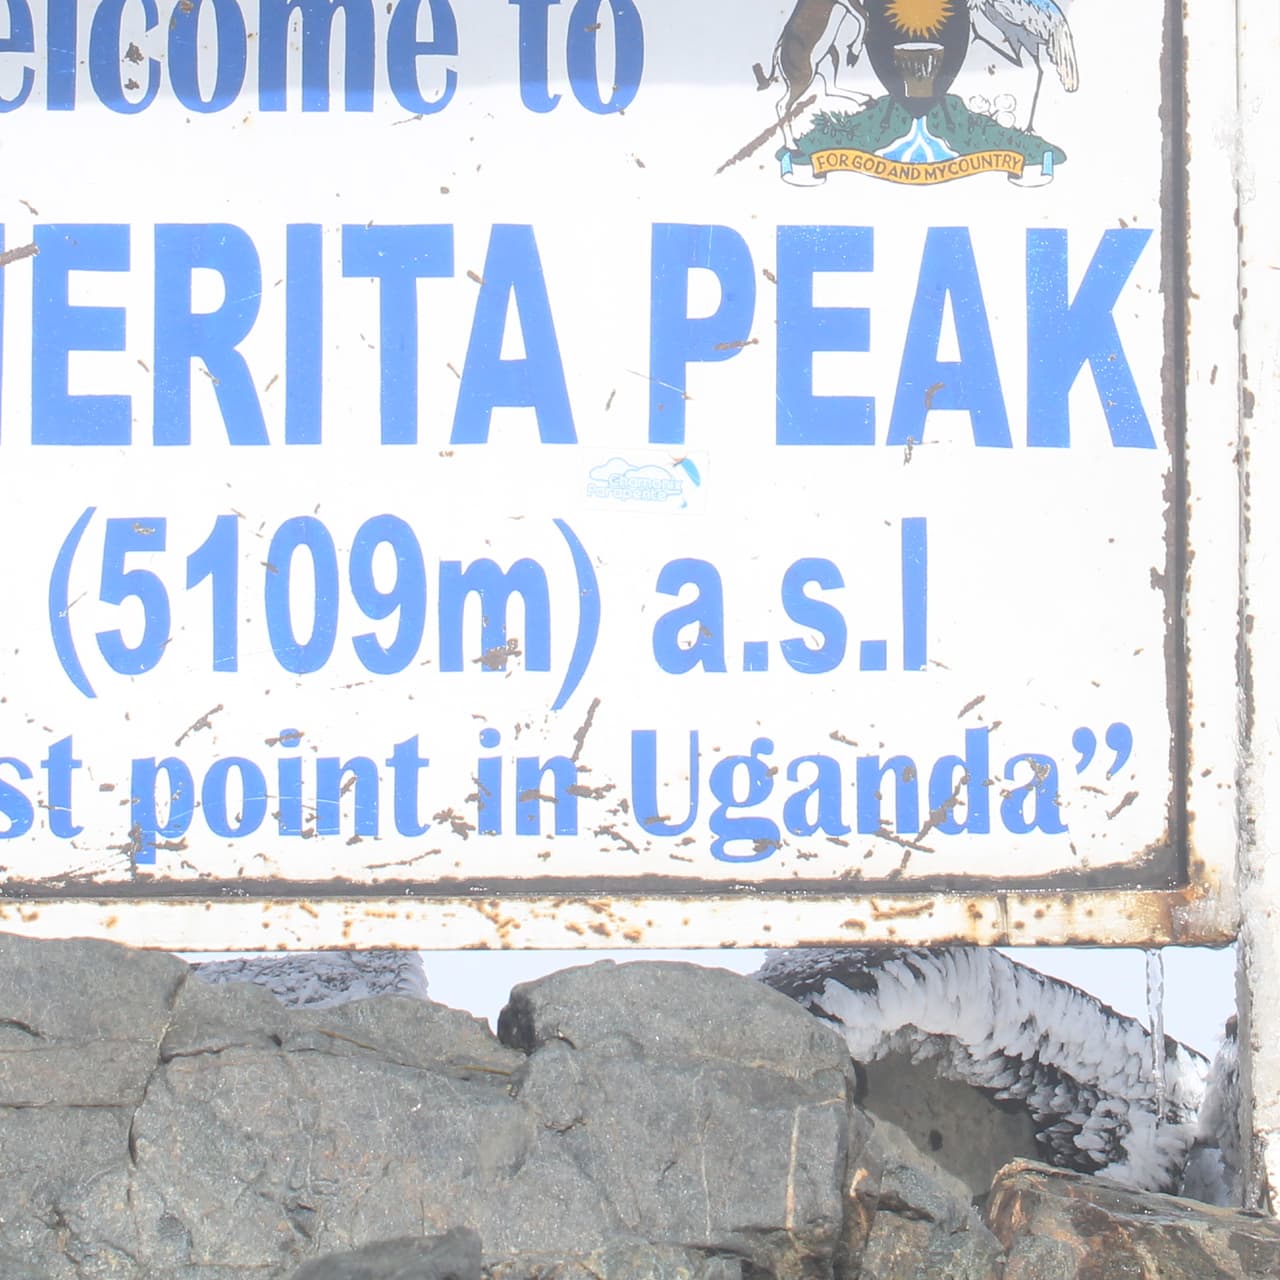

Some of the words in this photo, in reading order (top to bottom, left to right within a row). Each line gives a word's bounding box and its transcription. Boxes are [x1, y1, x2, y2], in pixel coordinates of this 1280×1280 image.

[816, 152, 849, 170] FOR
[851, 154, 888, 175] GOD
[887, 166, 920, 181] AND
[649, 222, 1157, 450] PEAK
[587, 482, 668, 502] Parapente
[608, 473, 683, 489] Chamonix
[49, 507, 601, 712] (5109m)
[652, 517, 928, 676] a.s.l
[130, 729, 430, 866] point
[477, 728, 579, 837] in
[631, 722, 1134, 864] Uganda”
